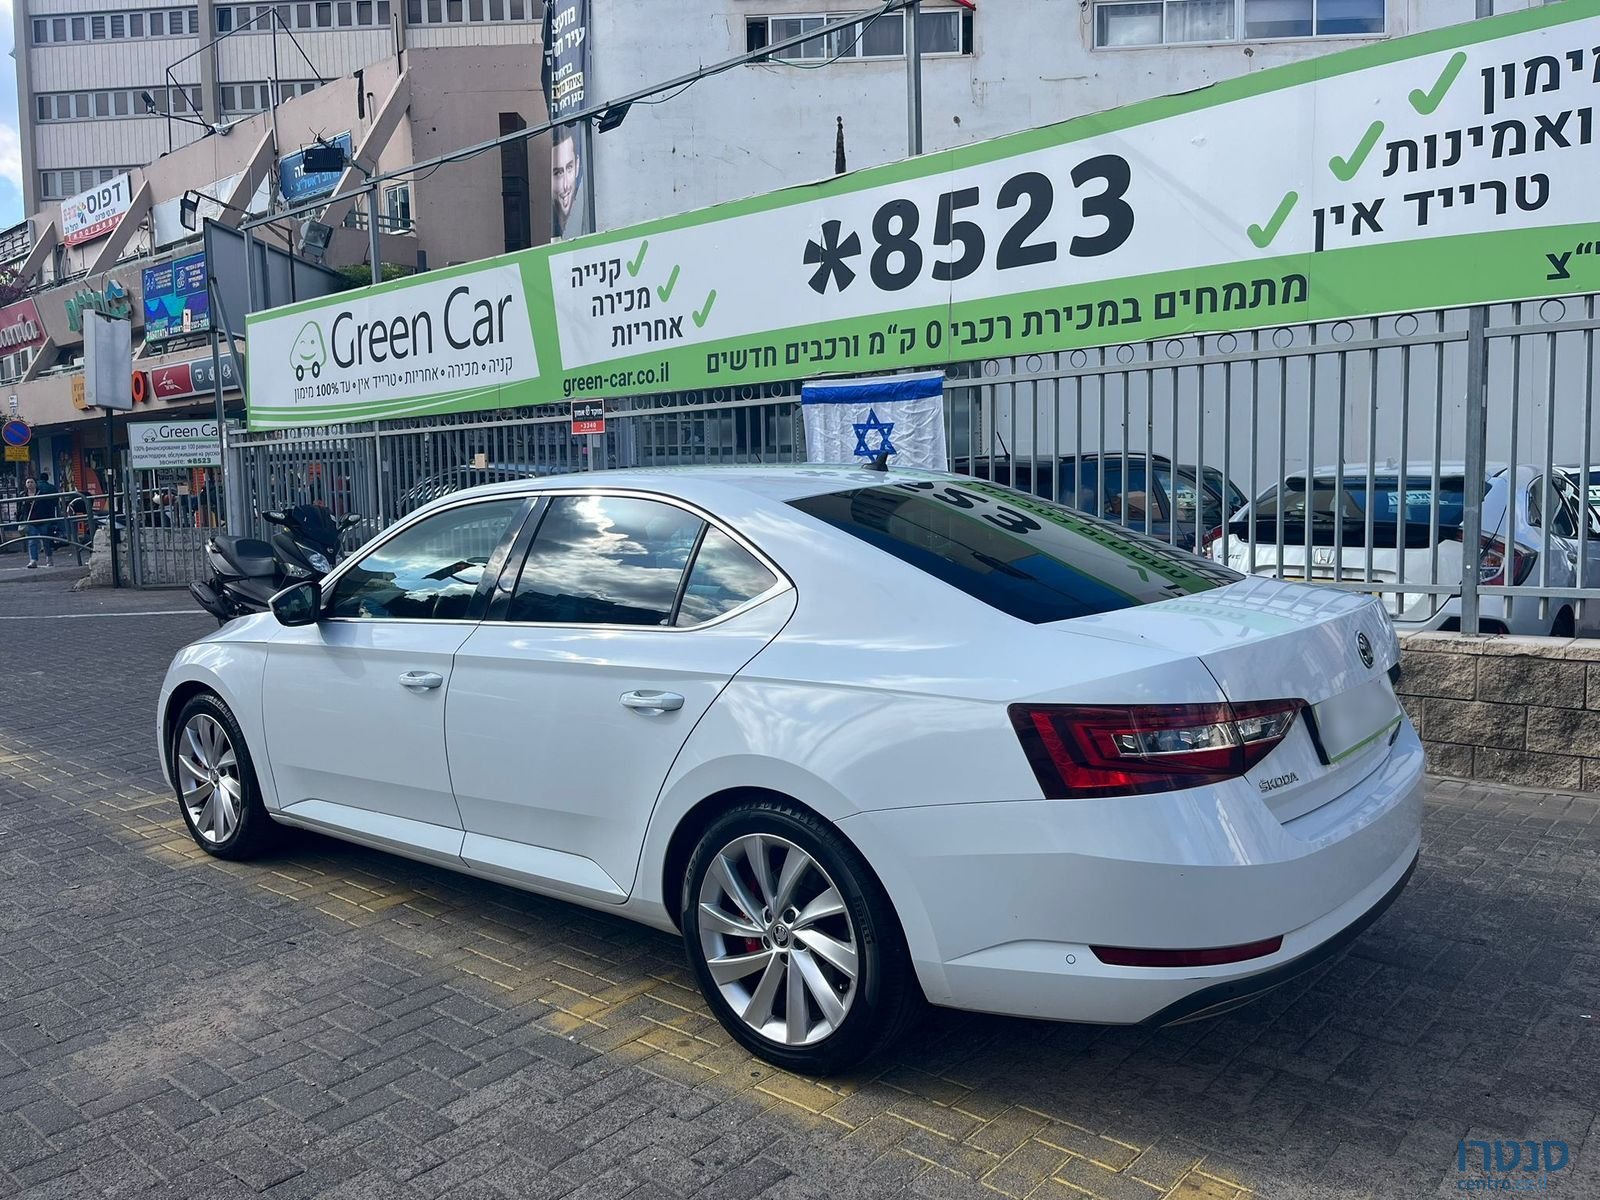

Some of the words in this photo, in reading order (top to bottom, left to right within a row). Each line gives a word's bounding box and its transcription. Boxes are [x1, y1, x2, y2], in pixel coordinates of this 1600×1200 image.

[565, 27, 585, 48] עיר
[1482, 46, 1600, 115] ימון
[1383, 107, 1592, 177] ואמינות
[86, 182, 120, 214] דפוס
[1404, 174, 1549, 226] טרייד
[1313, 198, 1385, 252] אין
[572, 259, 620, 288] קנייה
[1546, 241, 1600, 280] "צ
[593, 287, 650, 316] מכירה
[1155, 274, 1307, 320] מתמחים
[332, 311, 432, 368] Green
[444, 287, 512, 349] Car
[612, 316, 683, 347] אחריות
[951, 316, 1011, 345] רכבי
[1022, 298, 1141, 337] במכירת
[927, 321, 941, 348] 0
[708, 346, 776, 373] חדשים
[786, 335, 858, 365] ורכבים
[404, 367, 438, 385] אחריות
[448, 361, 479, 379] מכירה
[488, 356, 513, 376] קניה
[564, 362, 668, 397] green-car.co.il
[294, 386, 314, 404] מימון
[316, 382, 340, 396] 100%
[340, 380, 351, 393] עד
[358, 377, 370, 394] אין
[373, 373, 397, 389] טרייד
[160, 425, 198, 438] Green
[202, 424, 218, 436] Ca
[1258, 772, 1299, 792] ŠKODA
